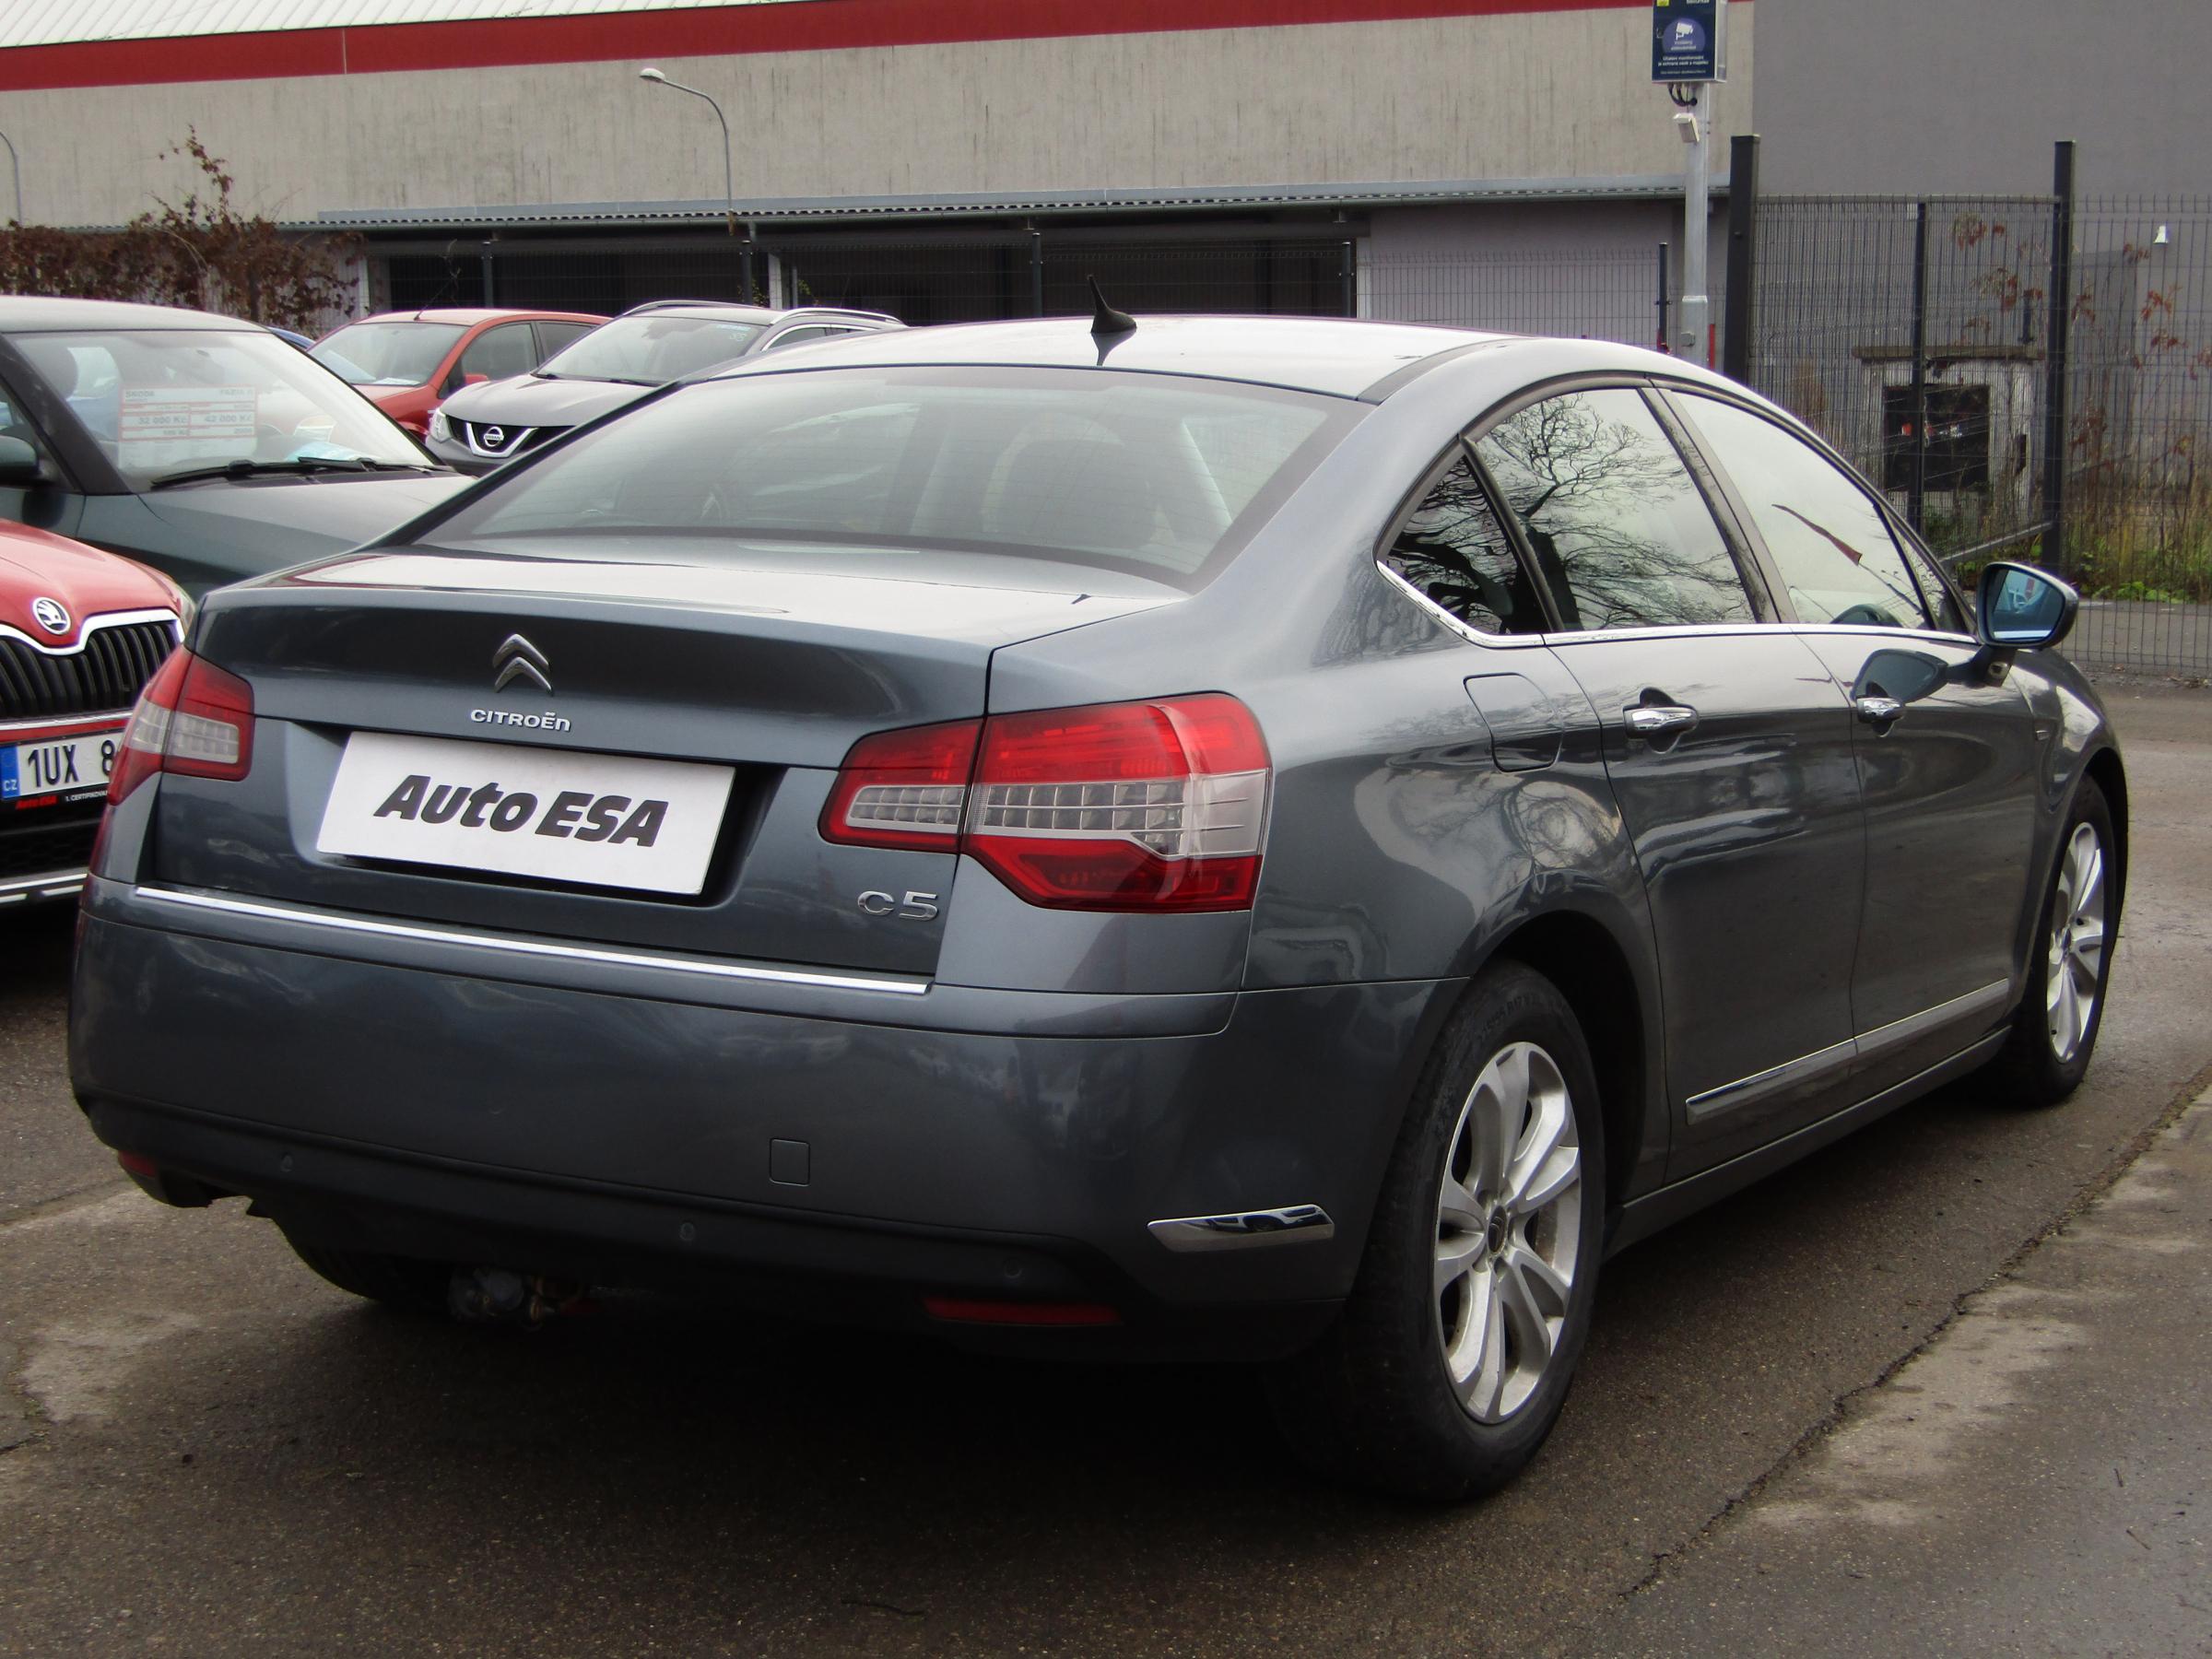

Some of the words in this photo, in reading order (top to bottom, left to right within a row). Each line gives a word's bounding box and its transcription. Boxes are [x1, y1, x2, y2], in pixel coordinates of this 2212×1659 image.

[3, 779, 18, 792] CZ
[28, 744, 80, 788] 1UX
[372, 774, 538, 832] Auto
[535, 791, 669, 847] ESA
